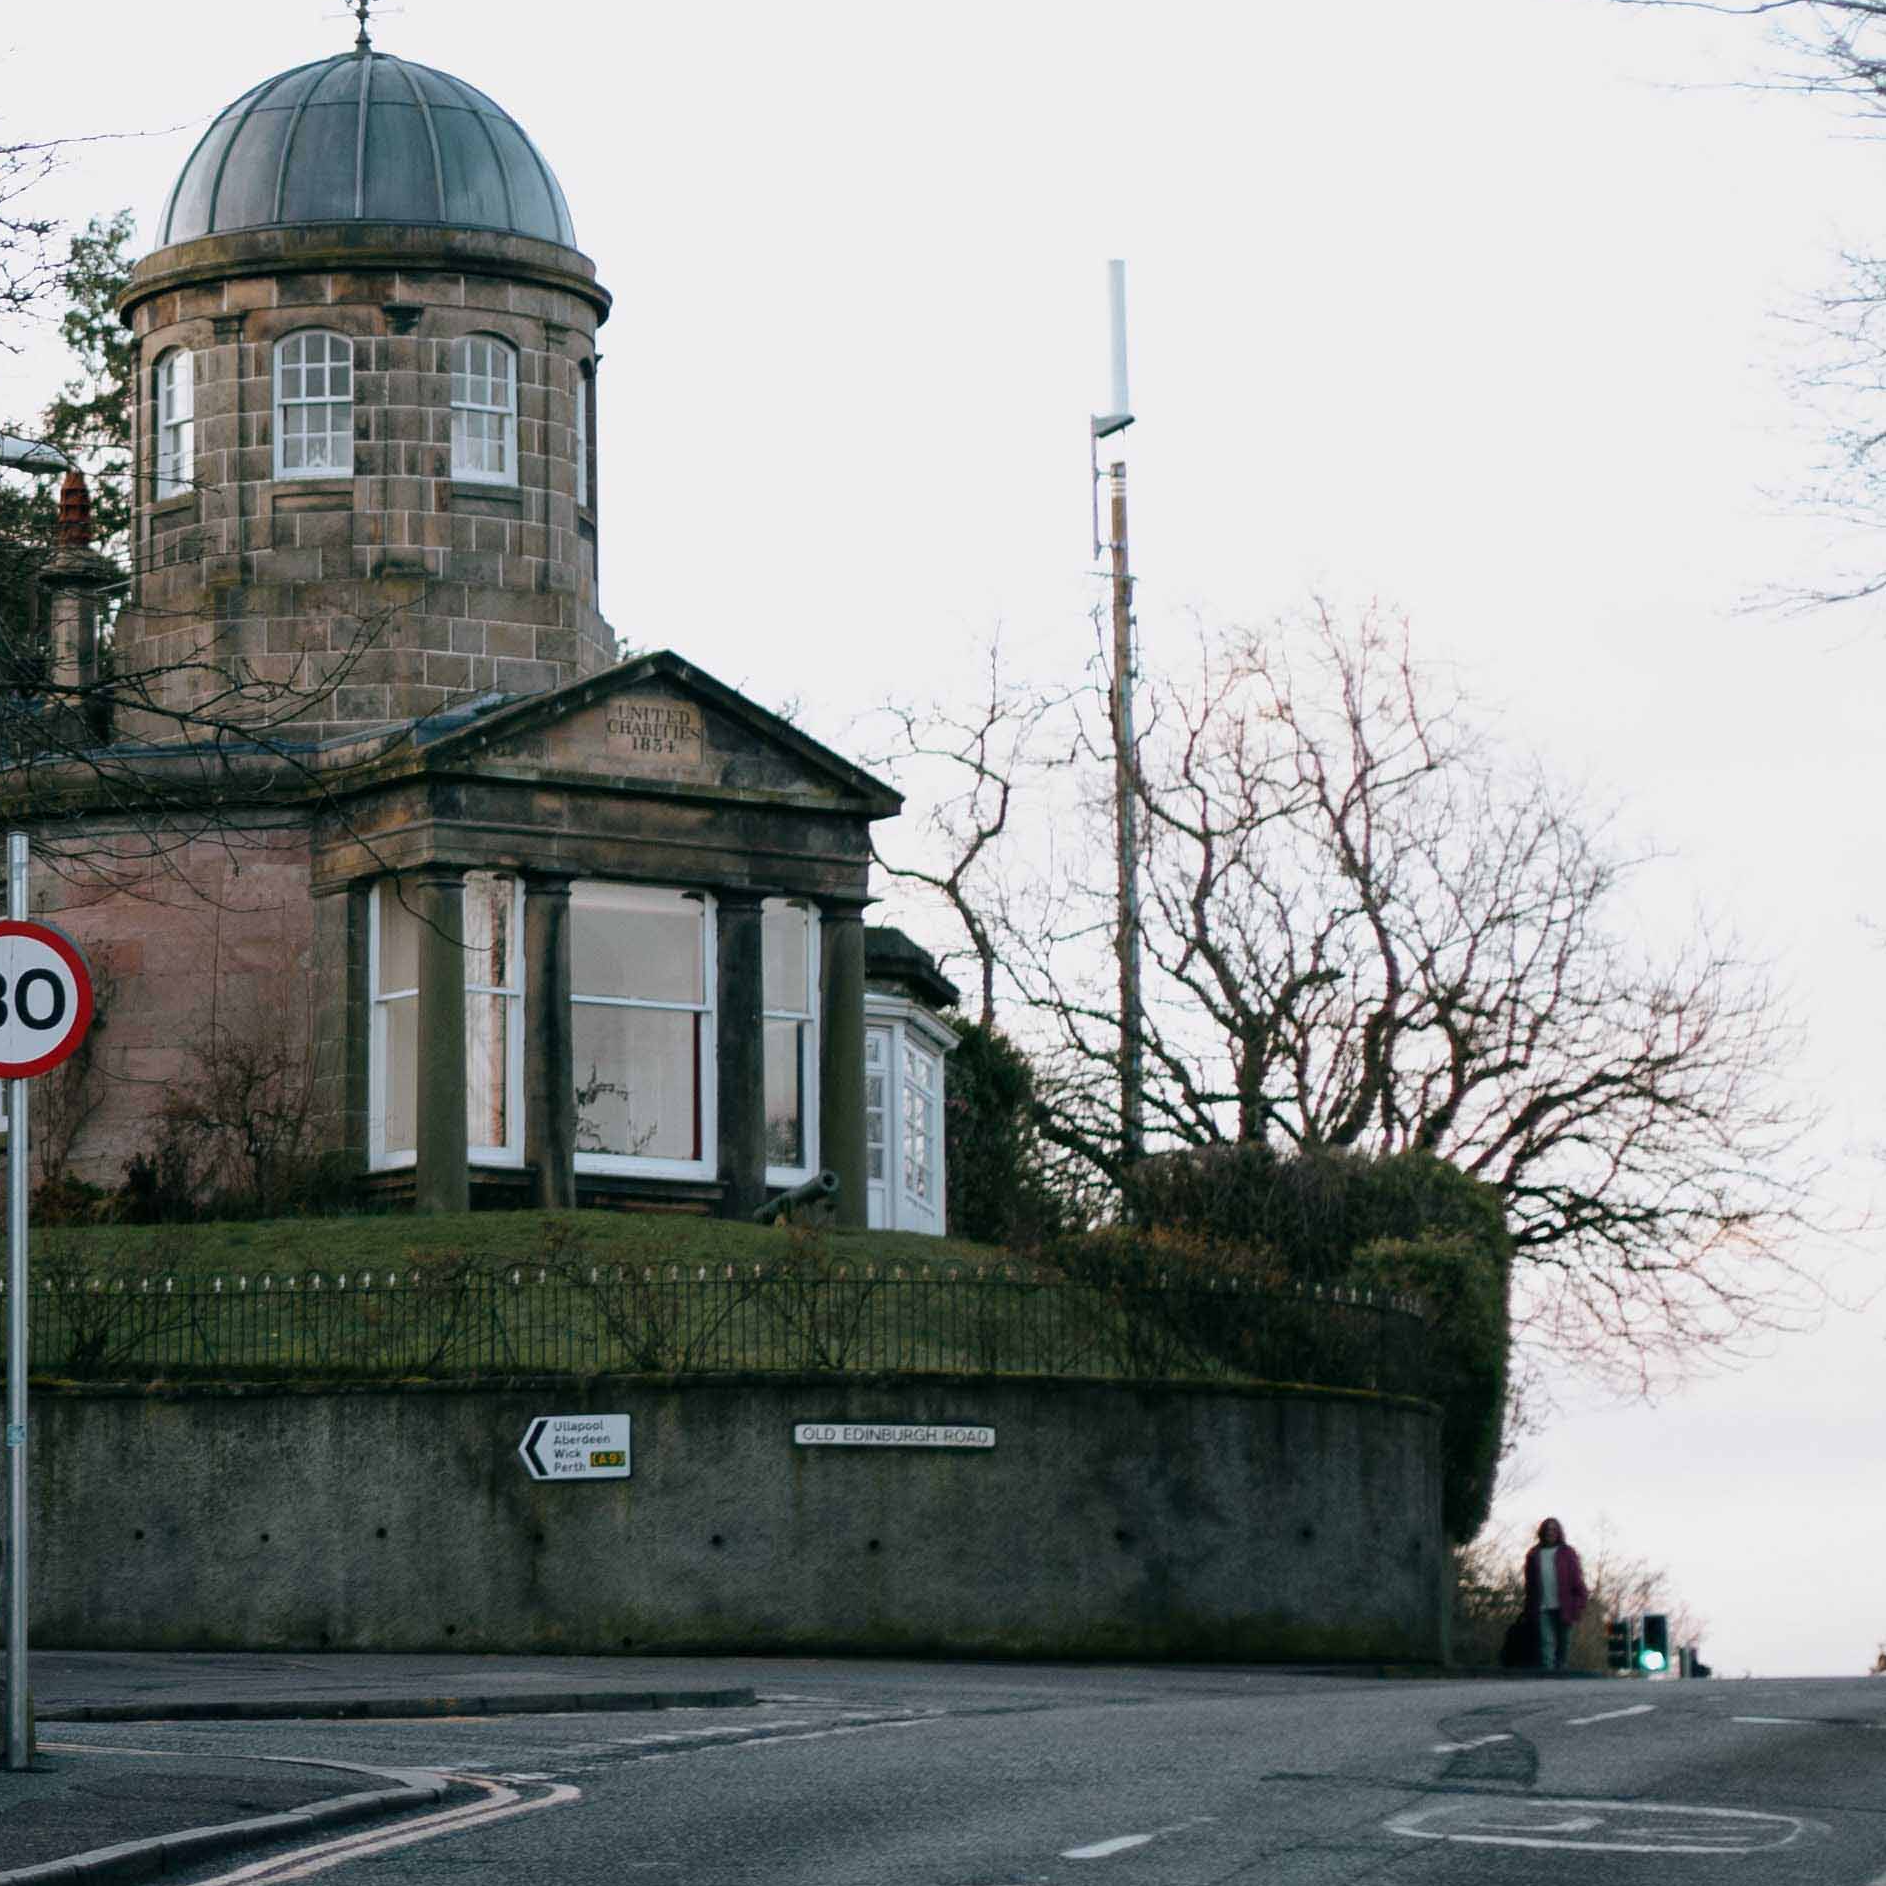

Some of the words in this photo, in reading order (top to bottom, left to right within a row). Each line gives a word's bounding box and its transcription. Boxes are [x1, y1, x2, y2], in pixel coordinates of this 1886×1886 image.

[618, 704, 691, 725] UNITED
[608, 718, 700, 739] CHARITIES
[553, 1420, 604, 1433] Ullapool
[553, 1434, 611, 1445] Aberdeen
[802, 1426, 836, 1441] OLD
[842, 1426, 938, 1443] EDINBURGH
[943, 1428, 988, 1444] ROAD
[553, 1449, 581, 1459] Wick
[553, 1461, 587, 1473] Perth
